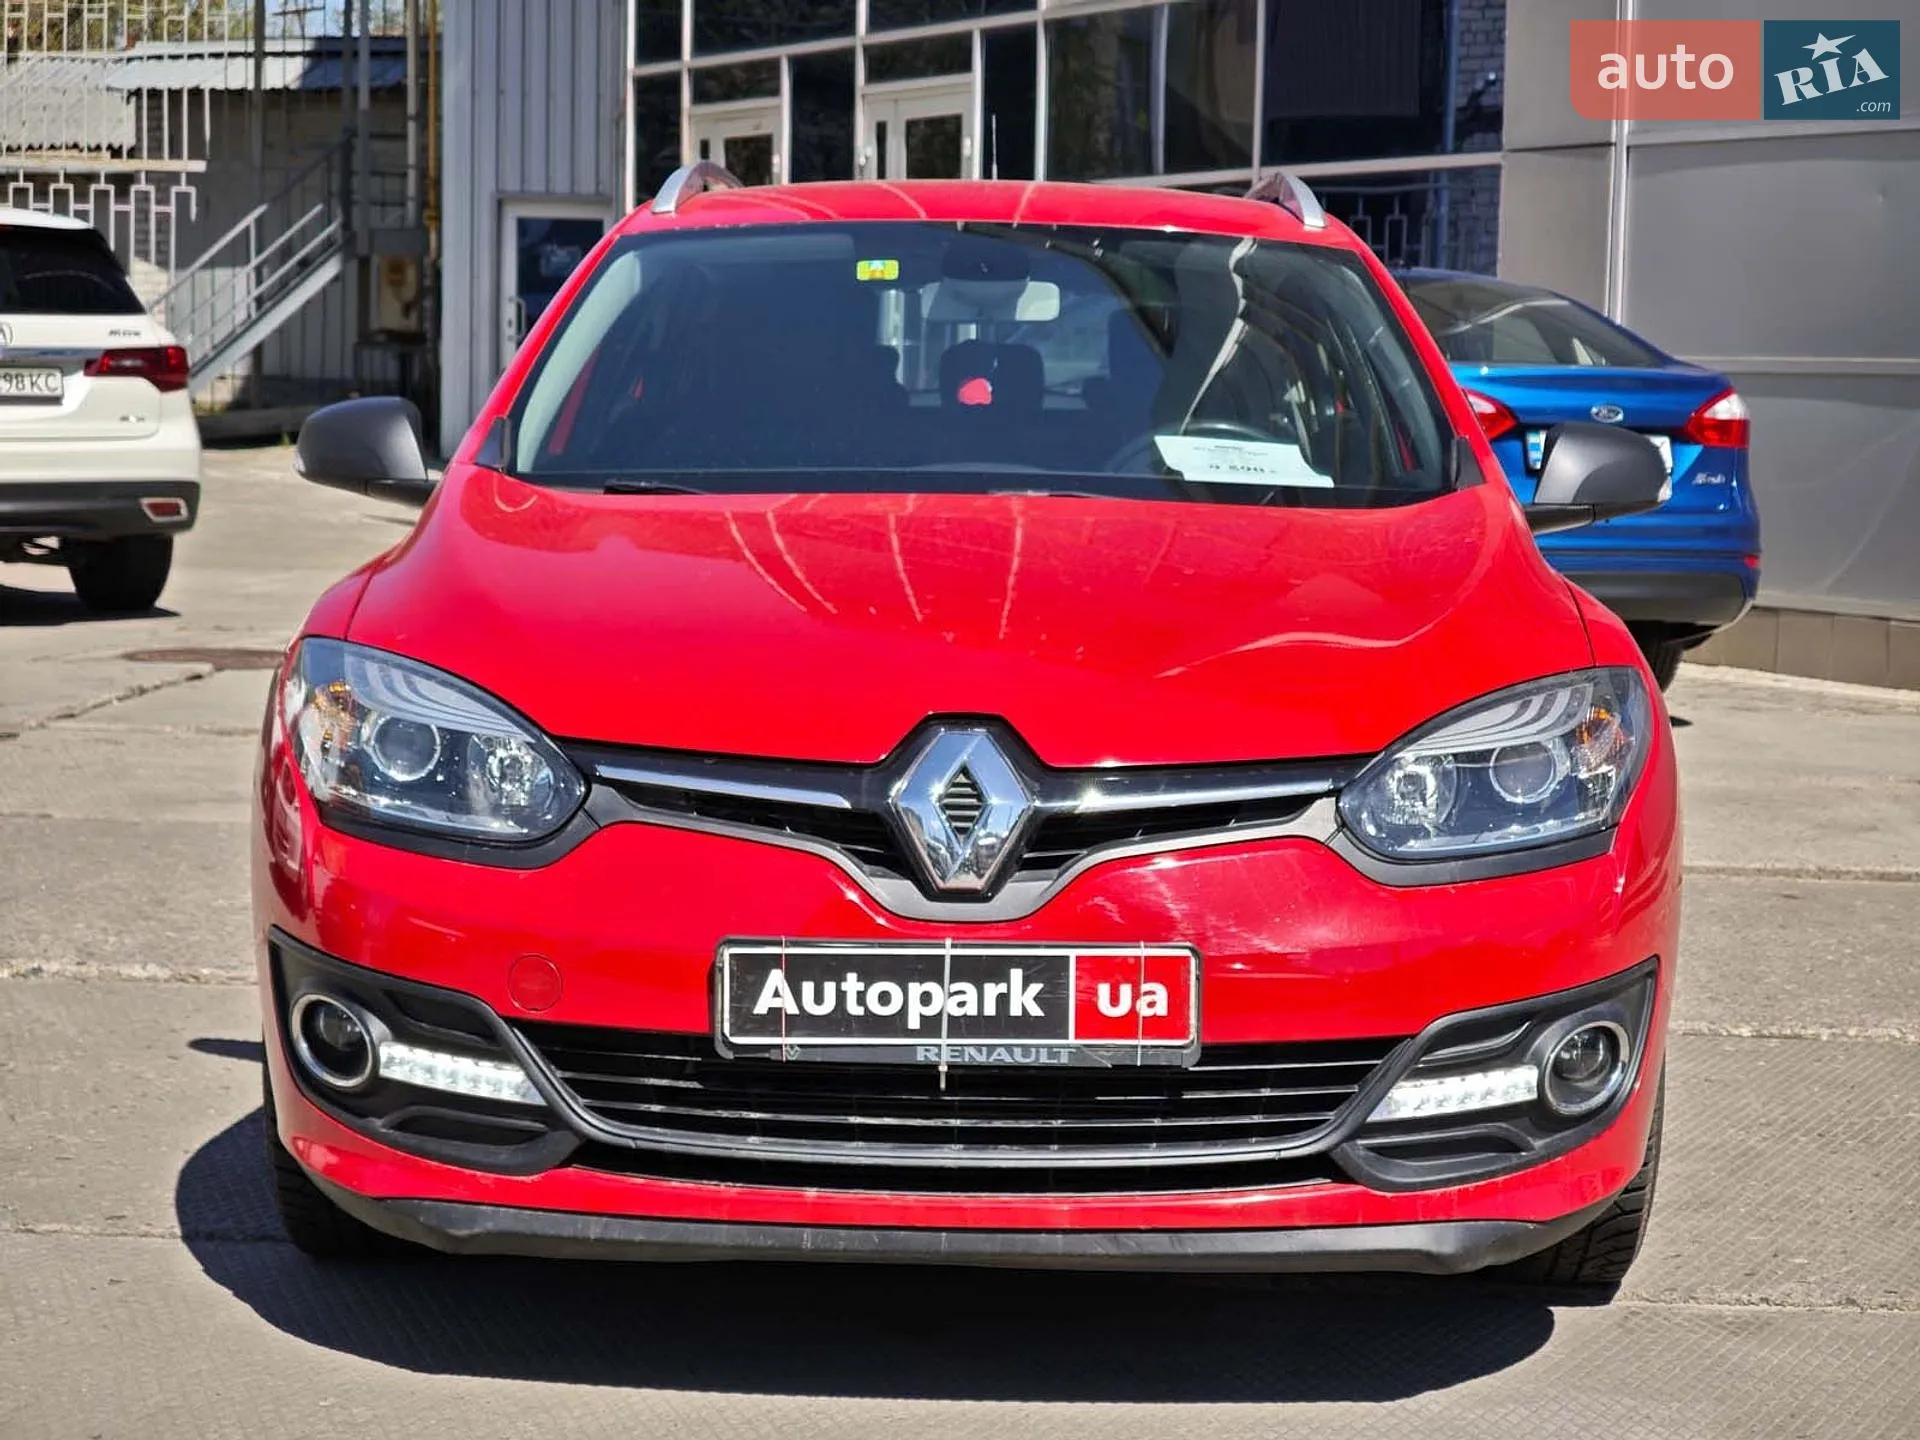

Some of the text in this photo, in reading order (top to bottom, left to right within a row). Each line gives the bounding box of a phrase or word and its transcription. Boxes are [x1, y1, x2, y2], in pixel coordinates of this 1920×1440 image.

[752, 968, 1169, 1030] Autopark ua
[915, 1045, 1077, 1064] RENAULT
